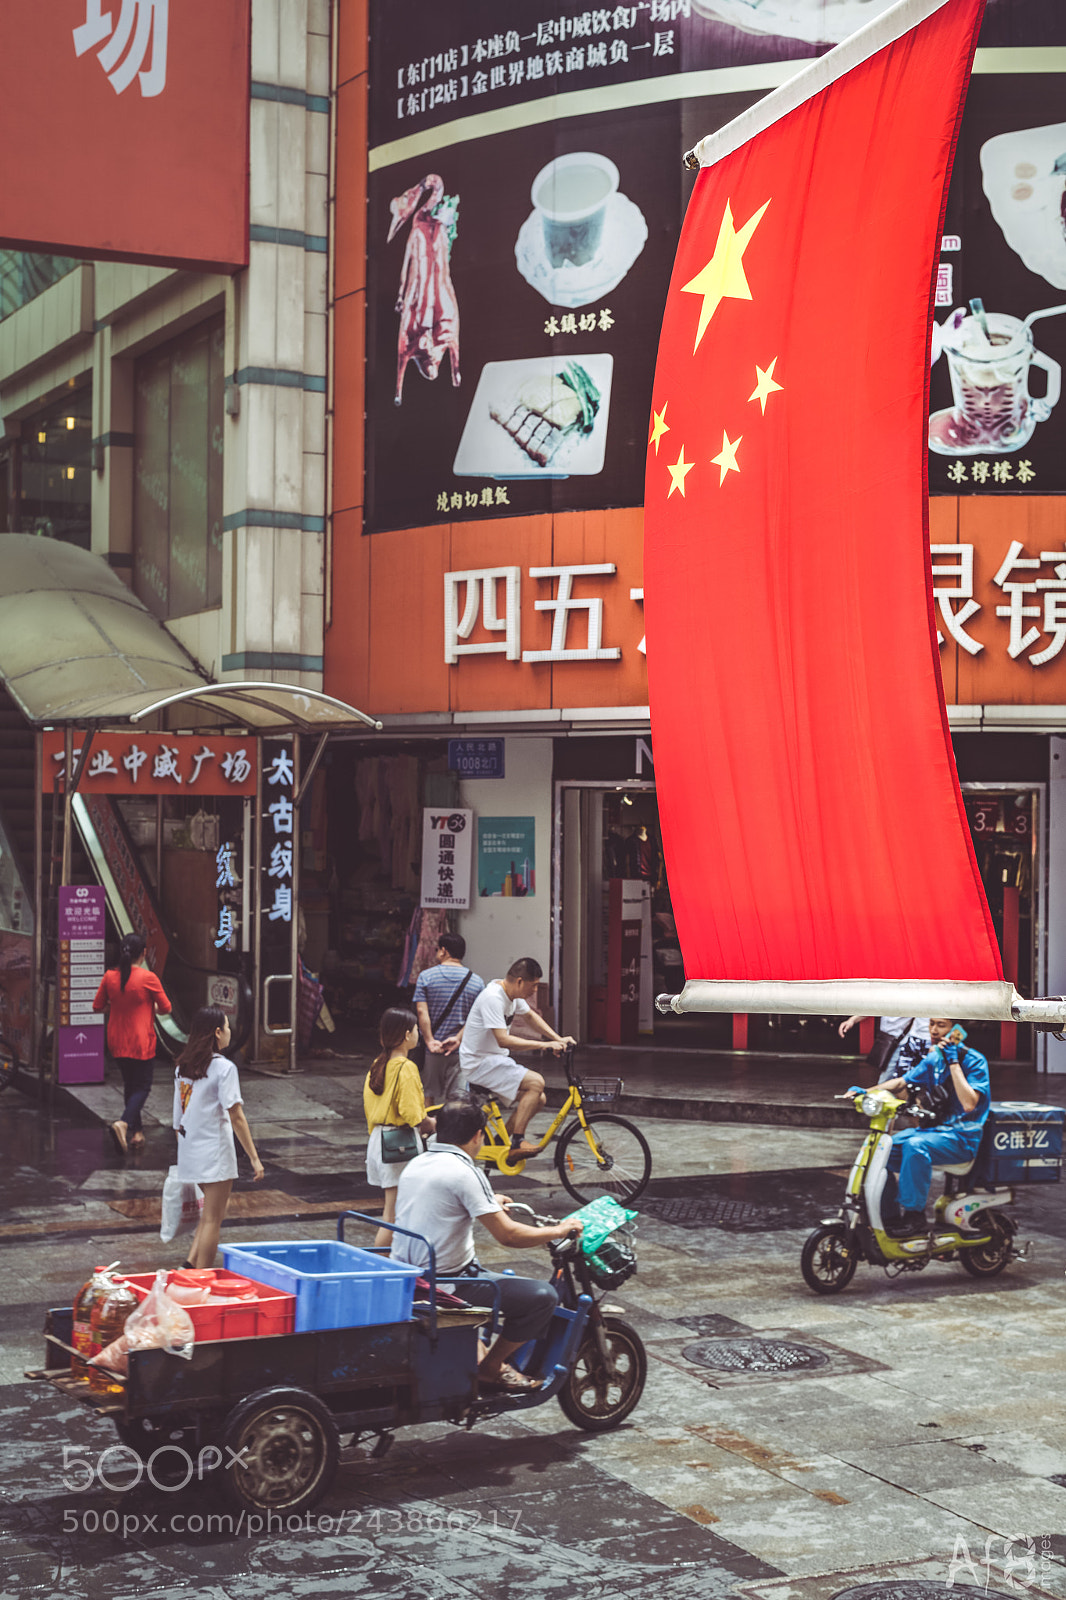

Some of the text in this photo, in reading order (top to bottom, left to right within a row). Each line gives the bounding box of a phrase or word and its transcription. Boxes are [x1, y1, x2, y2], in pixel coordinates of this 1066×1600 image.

[397, 29, 675, 119] 【东门2店】金世界地铁商城负一层
[443, 563, 645, 665] 四五
[456, 757, 498, 770] 1008北门
